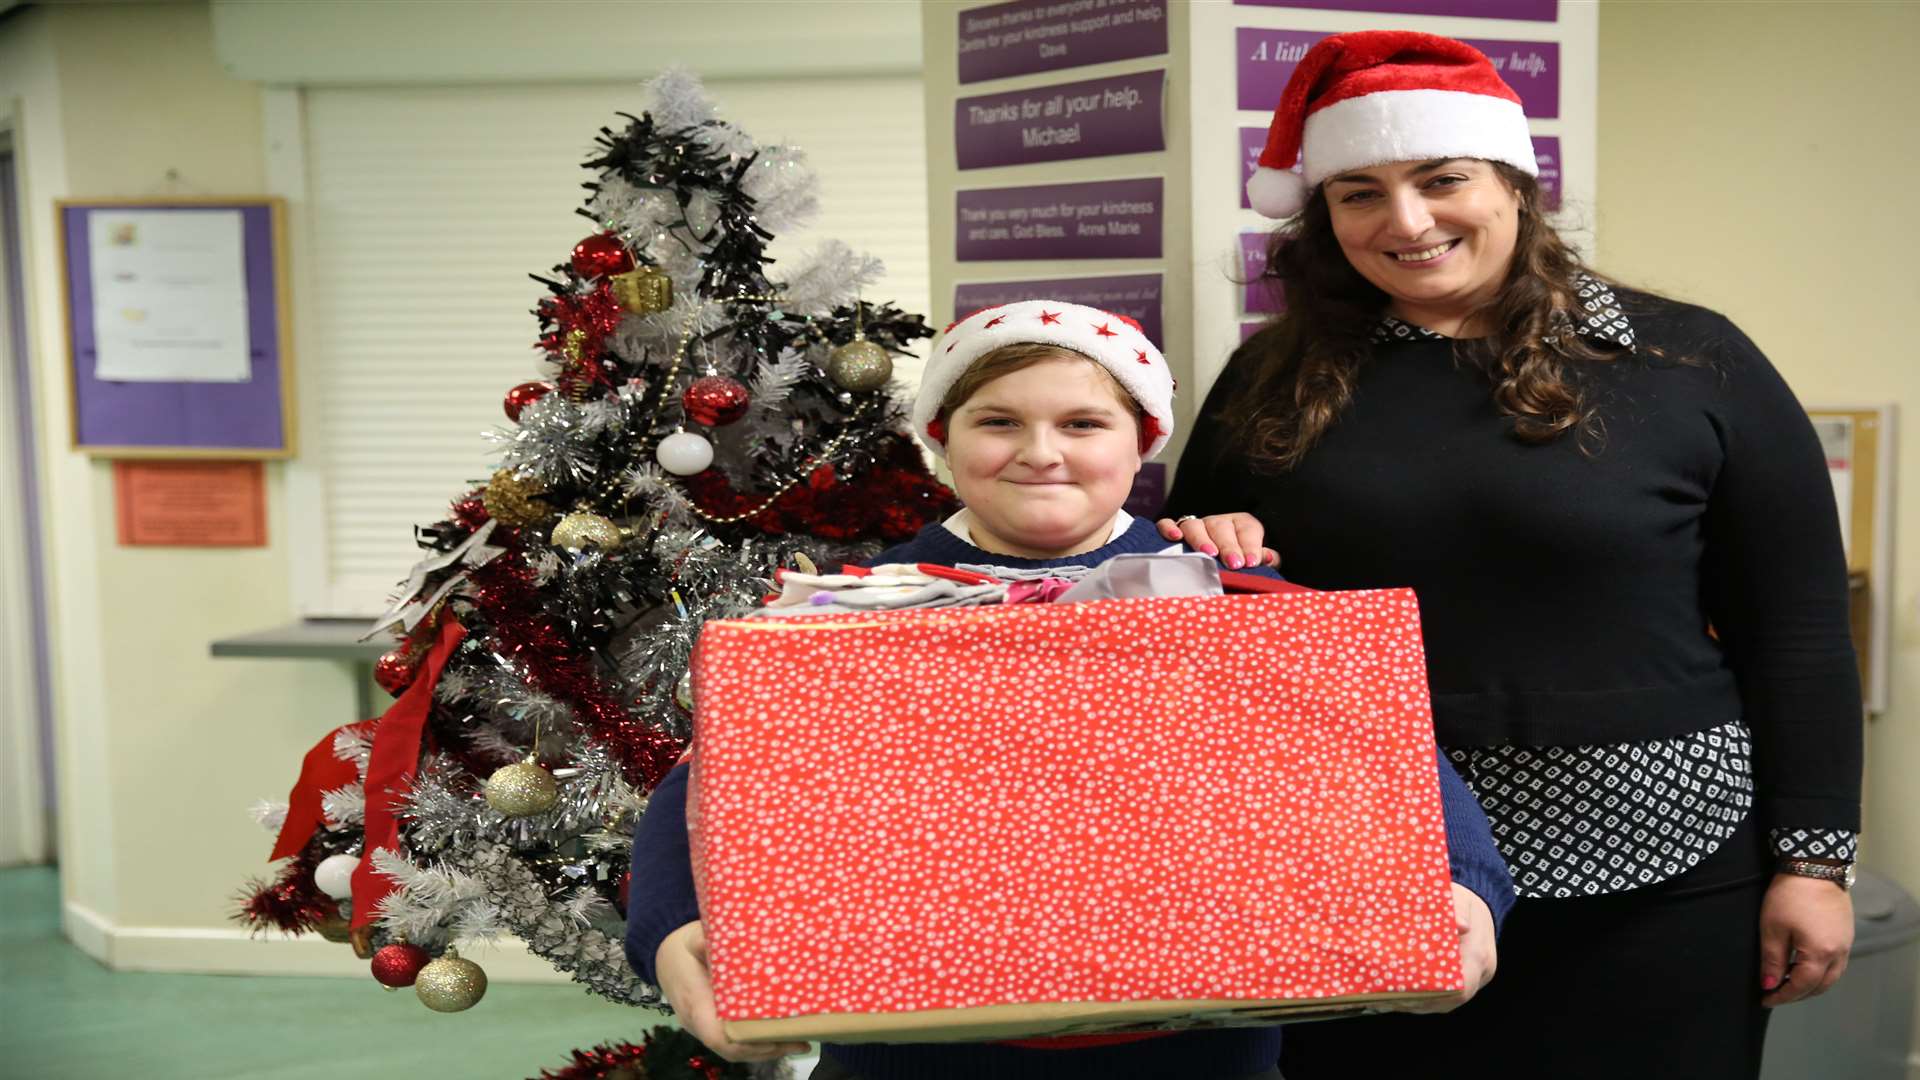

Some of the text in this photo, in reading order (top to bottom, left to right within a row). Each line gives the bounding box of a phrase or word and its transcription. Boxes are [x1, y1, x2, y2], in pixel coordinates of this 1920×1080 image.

[1002, 10, 1033, 25] thanks
[1035, 7, 1045, 19] to
[1047, 1, 1093, 18] everyone
[988, 34, 1001, 47] for
[1002, 31, 1023, 47] your
[1023, 23, 1068, 39] kindness
[1070, 15, 1110, 33] support
[1111, 9, 1134, 26] and
[1039, 42, 1067, 58] Dave
[1250, 40, 1268, 61] A
[1509, 52, 1548, 79] help.
[968, 86, 1143, 125] Thanks for all your help.
[1022, 122, 1081, 148] Michael
[960, 200, 1154, 224] Thank you very much for your kindness
[968, 227, 987, 241] and
[1012, 223, 1034, 240] God
[1077, 221, 1106, 236] Anne
[1107, 220, 1140, 235] Marie
